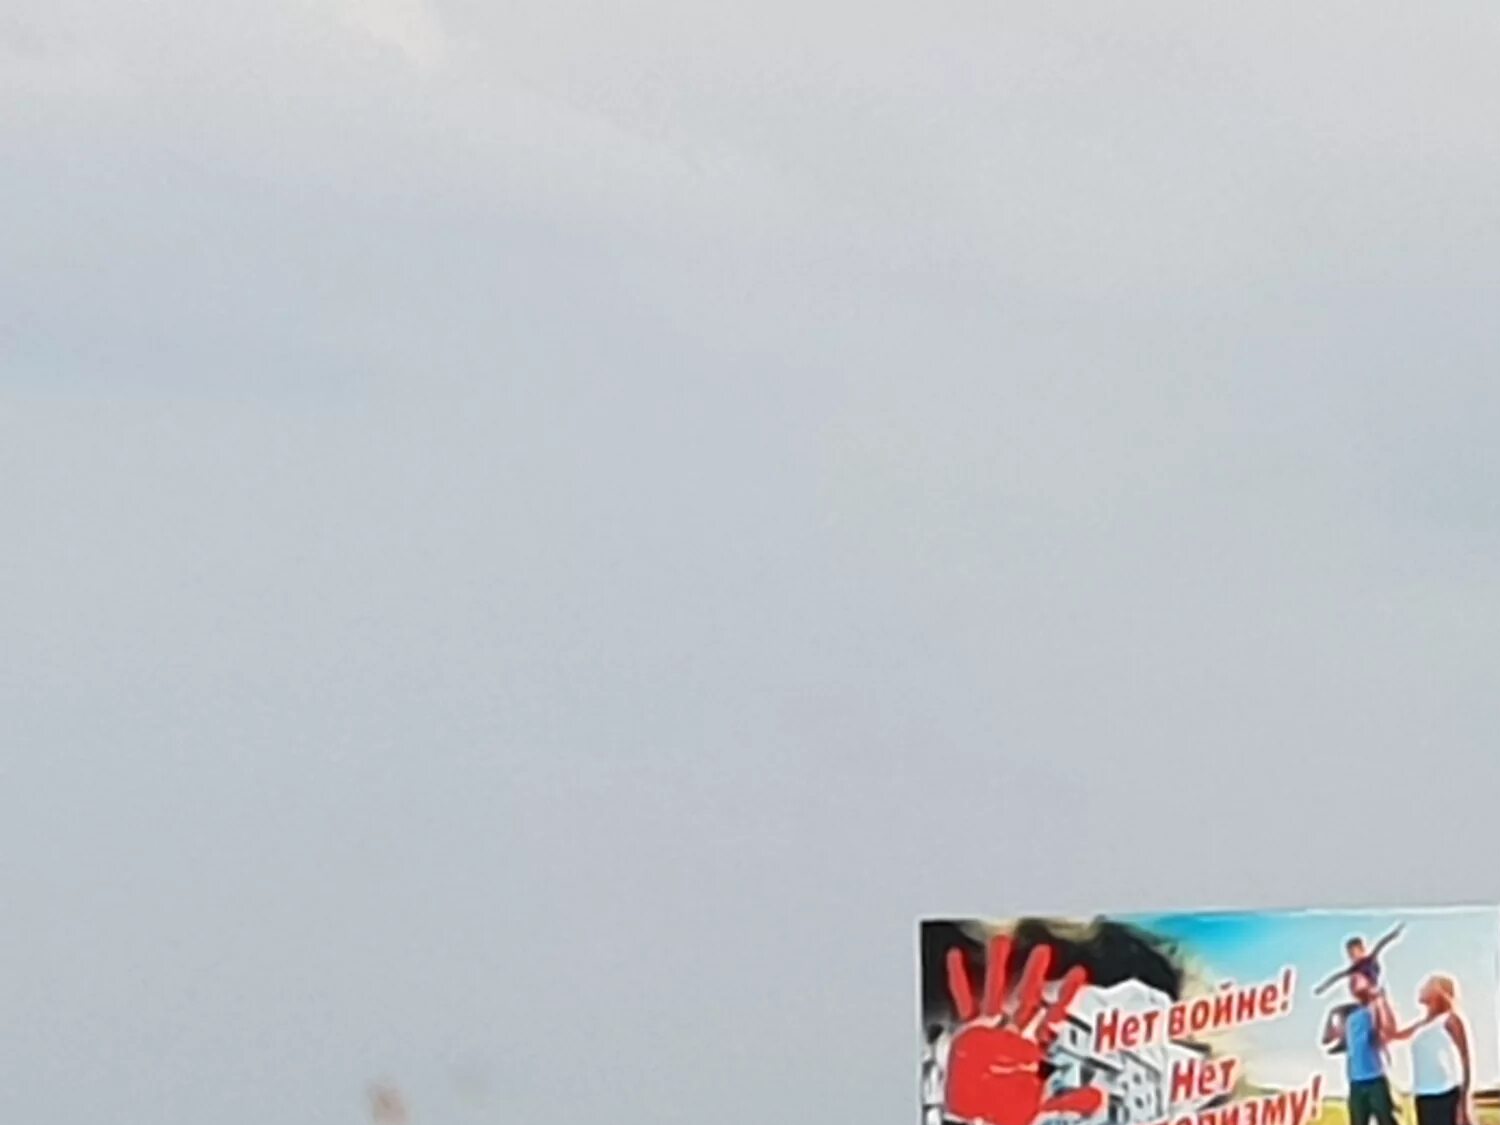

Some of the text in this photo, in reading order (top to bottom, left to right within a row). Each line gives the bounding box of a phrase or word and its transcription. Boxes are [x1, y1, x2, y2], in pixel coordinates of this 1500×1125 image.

[1094, 968, 1292, 1051] Нет войне!
[1171, 1058, 1236, 1102] Нет
